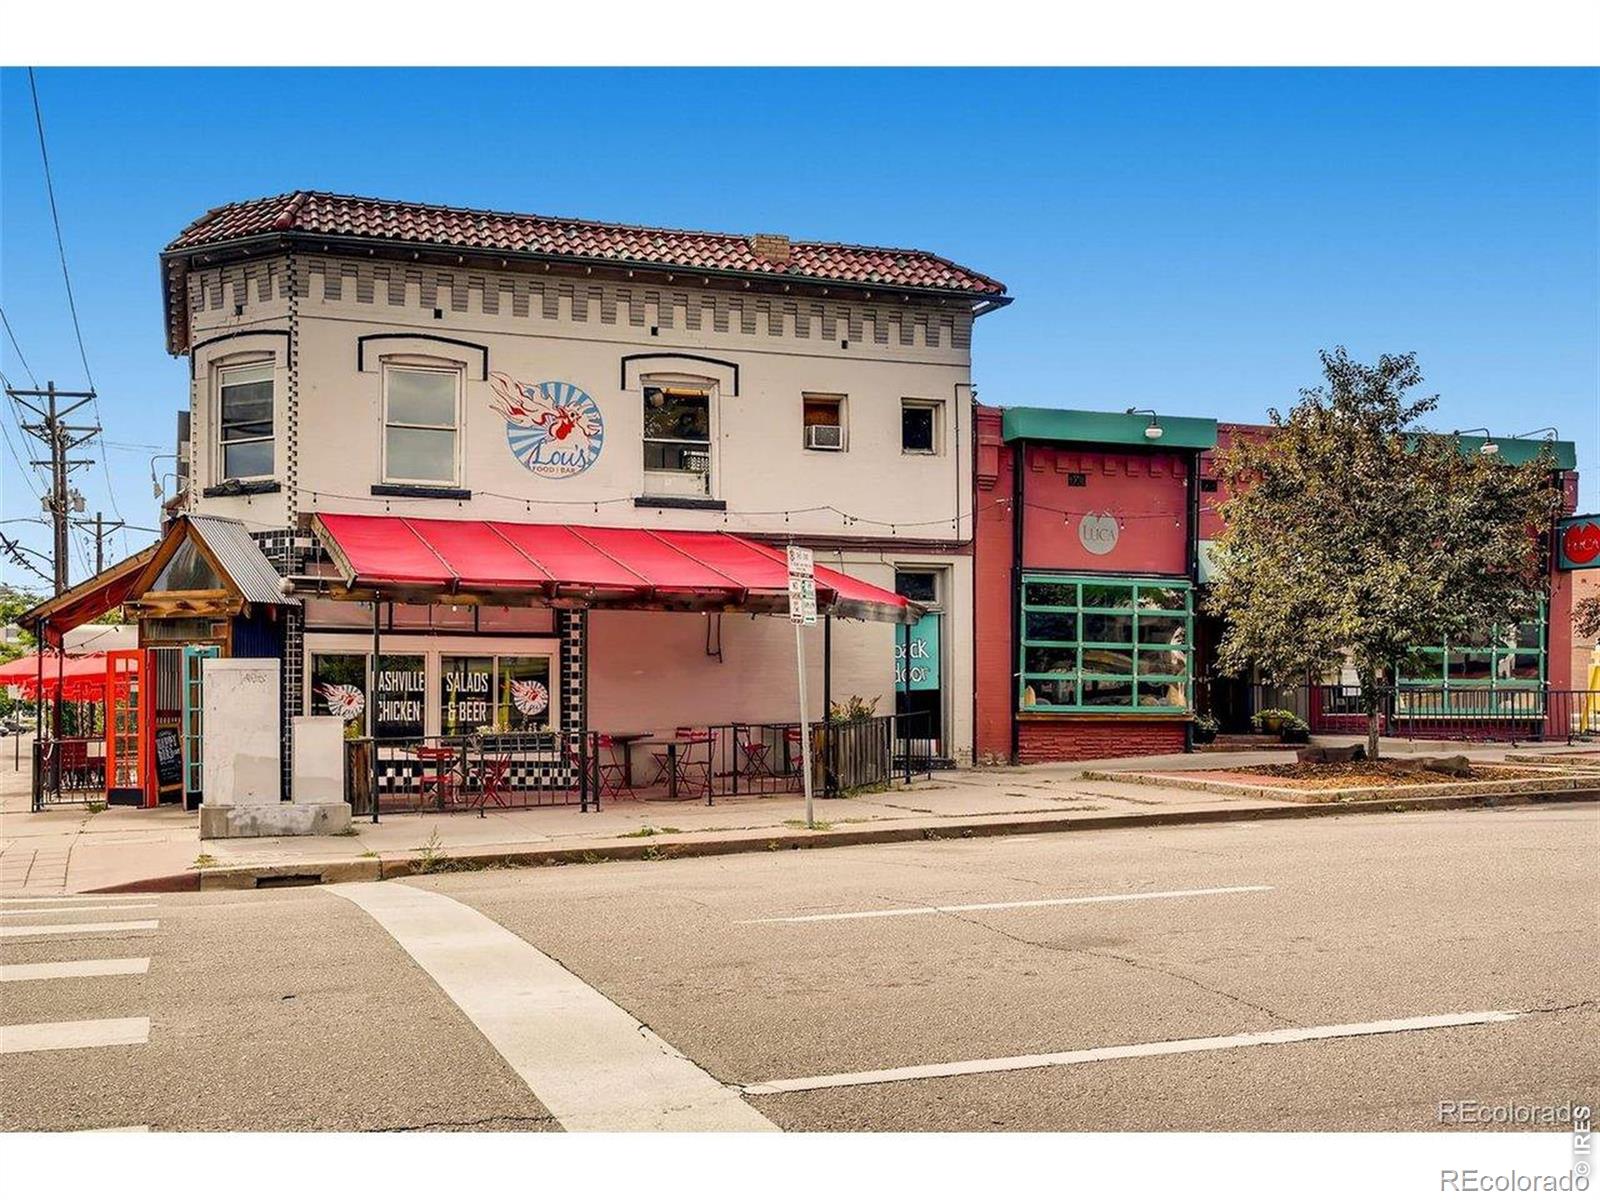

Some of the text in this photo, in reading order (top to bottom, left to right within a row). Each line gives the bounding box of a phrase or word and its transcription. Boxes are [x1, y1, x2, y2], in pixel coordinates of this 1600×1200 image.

[528, 438, 586, 470] Lou's
[446, 672, 489, 692] SALADS
[448, 701, 487, 721] & BEER
